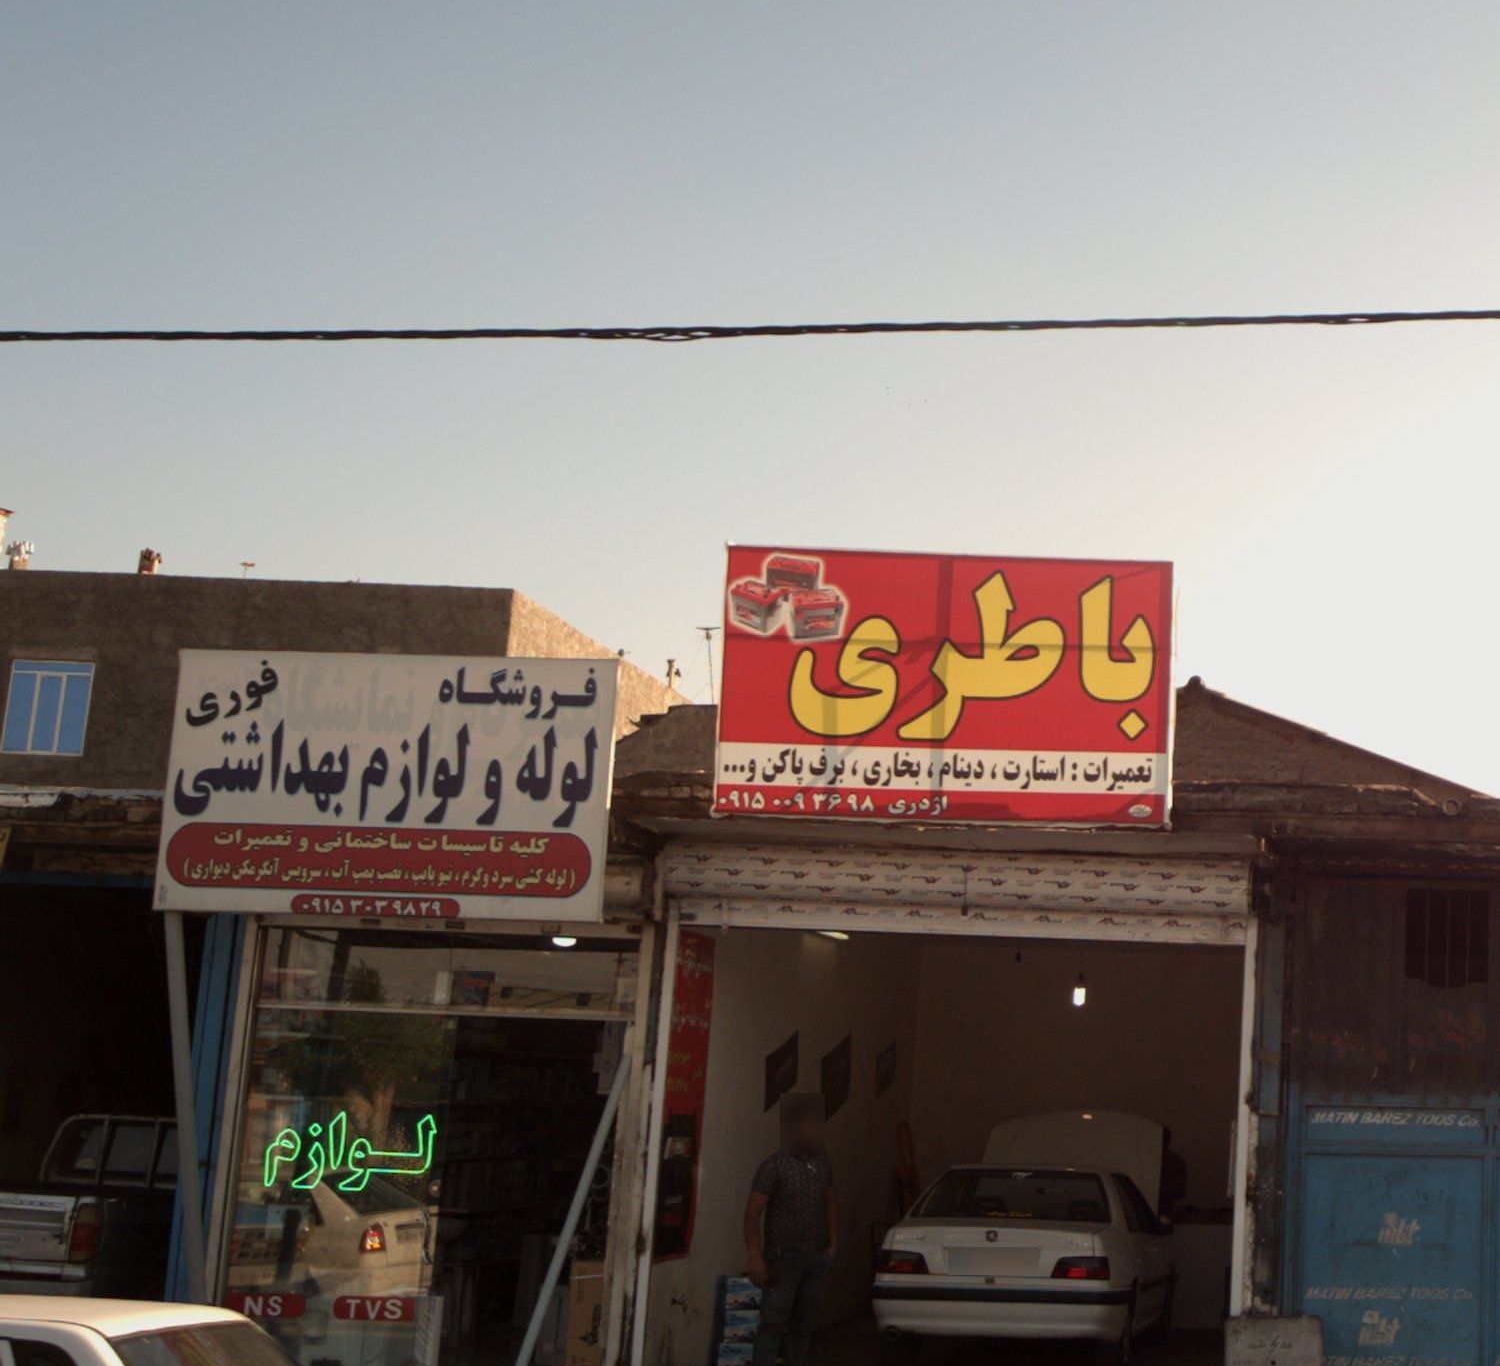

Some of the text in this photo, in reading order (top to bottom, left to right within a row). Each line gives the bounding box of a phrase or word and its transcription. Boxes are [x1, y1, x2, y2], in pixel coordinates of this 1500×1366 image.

[789, 568, 1155, 741] باطری
[186, 659, 278, 727] فوری
[438, 666, 598, 720] فروشگاه
[173, 718, 599, 828] لوله و لوازم بهداشتی
[213, 828, 293, 851] تعمیرات
[296, 836, 309, 852] و
[313, 830, 412, 853] ساختمانی
[509, 836, 550, 857] کلیه
[1309, 1112, 1360, 1125] MATIN
[1360, 1112, 1412, 1126] BAREZ
[1415, 1114, 1457, 1127] TOOS
[263, 1111, 438, 1191] لوازم
[344, 1297, 404, 1321] TVS
